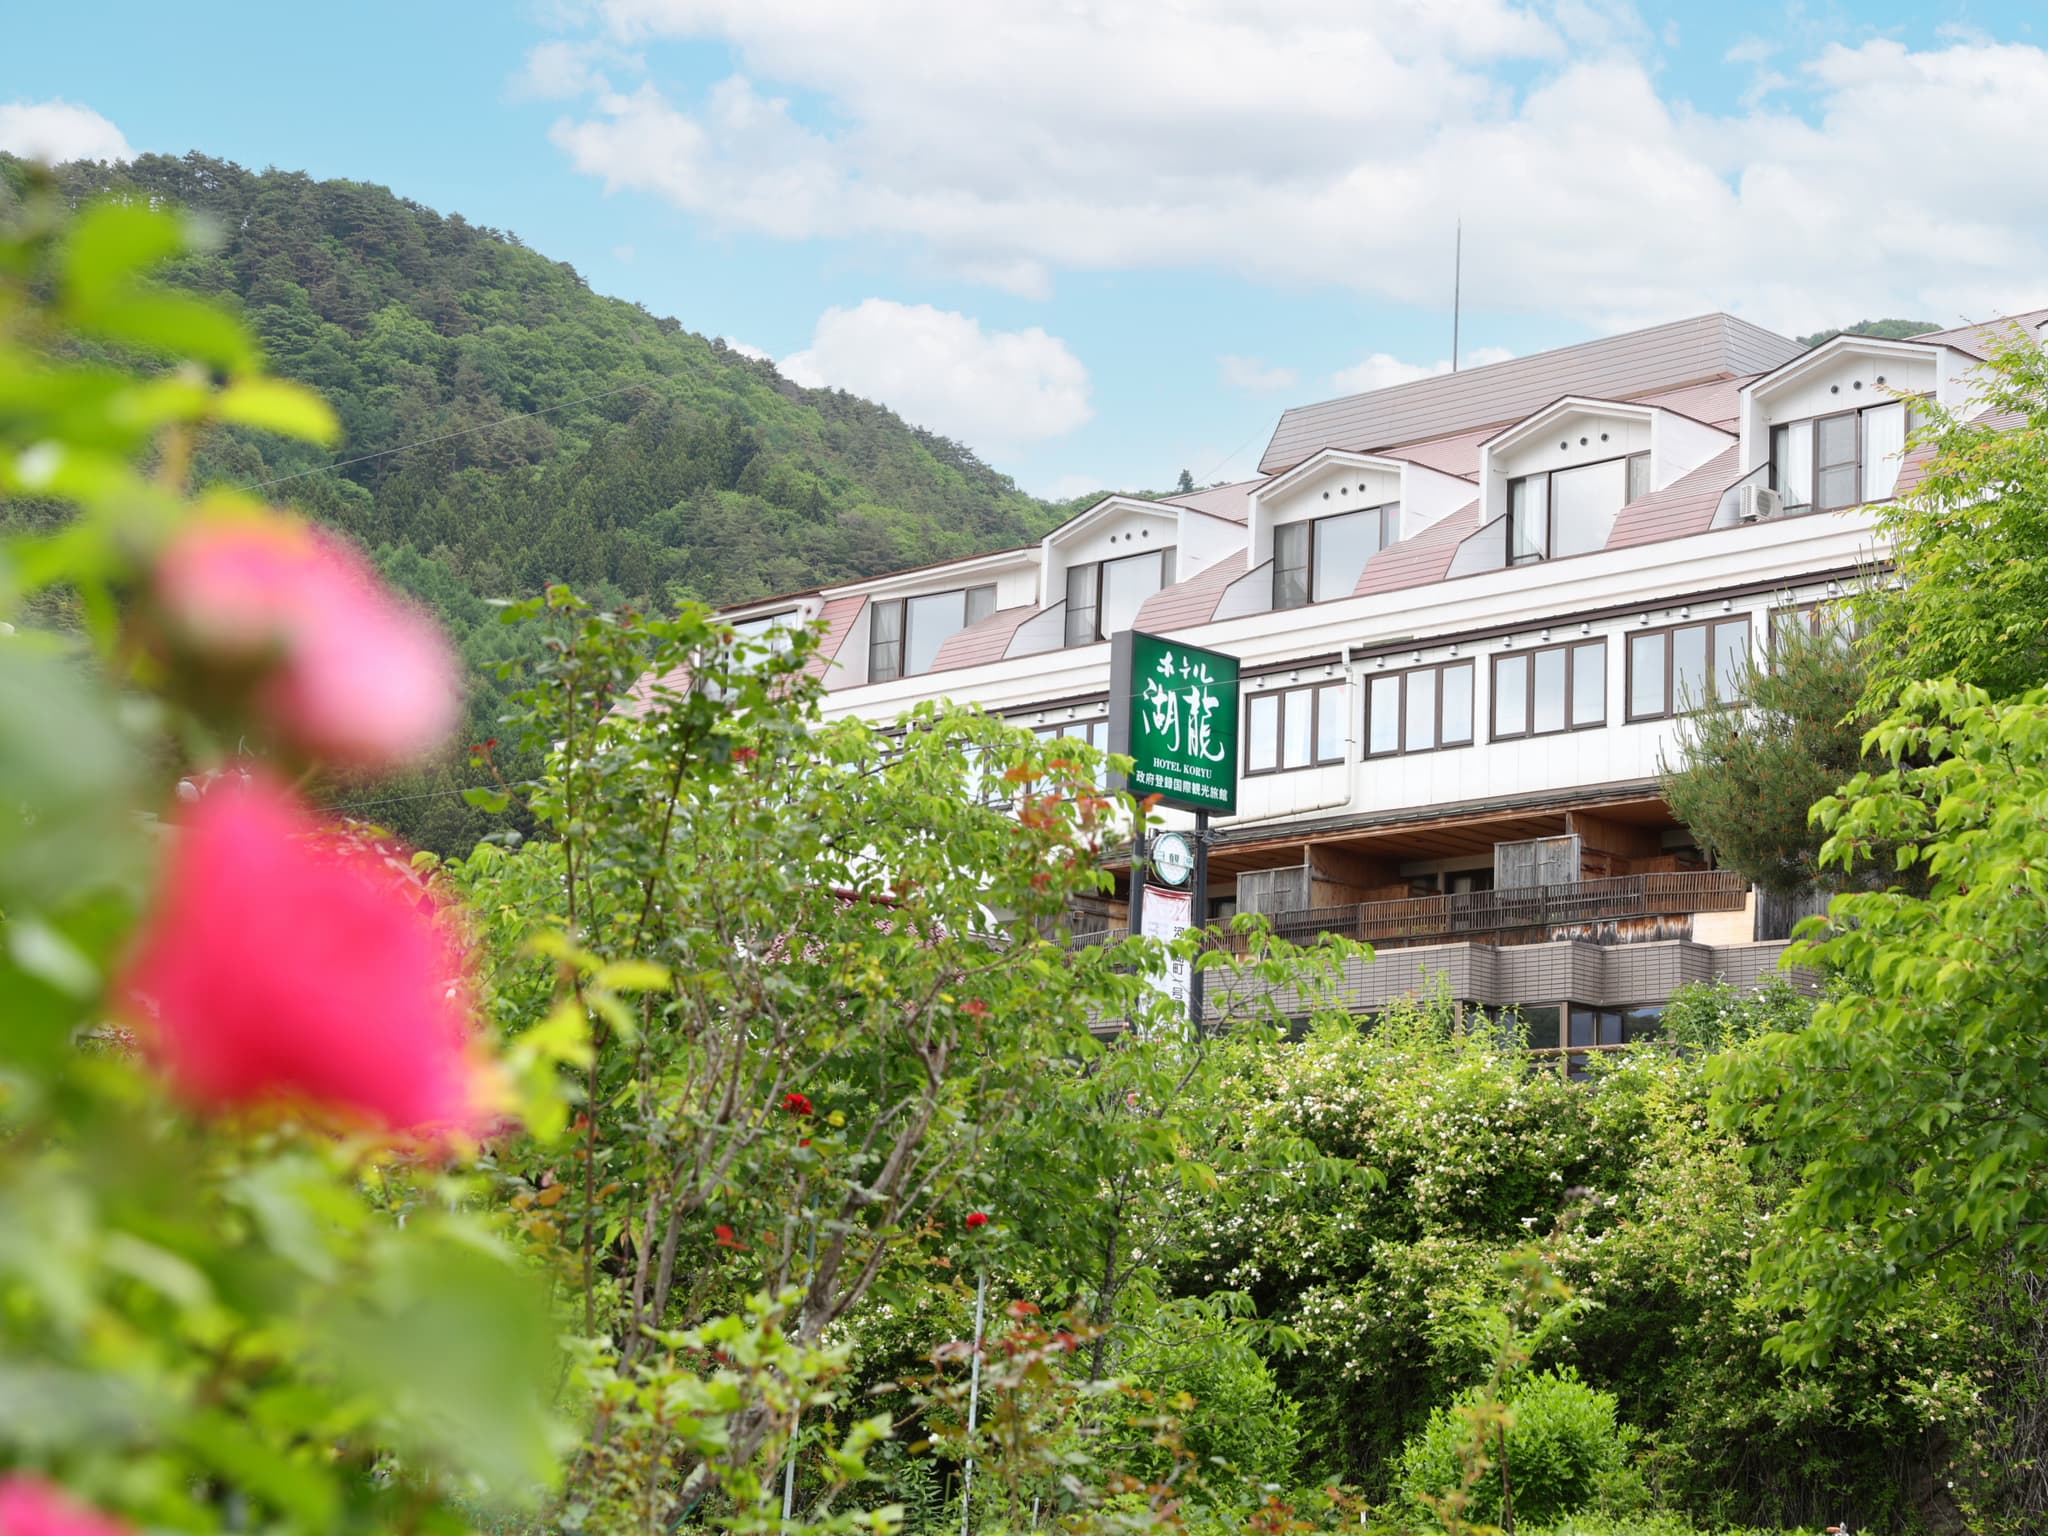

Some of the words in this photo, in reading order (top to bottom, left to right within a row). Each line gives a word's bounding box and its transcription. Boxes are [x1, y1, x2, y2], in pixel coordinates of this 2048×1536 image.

[1157, 651, 1214, 683] ホテル
[1143, 677, 1225, 762] 湖龍
[1153, 757, 1182, 773] HOTEL
[1183, 764, 1213, 779] KORYU
